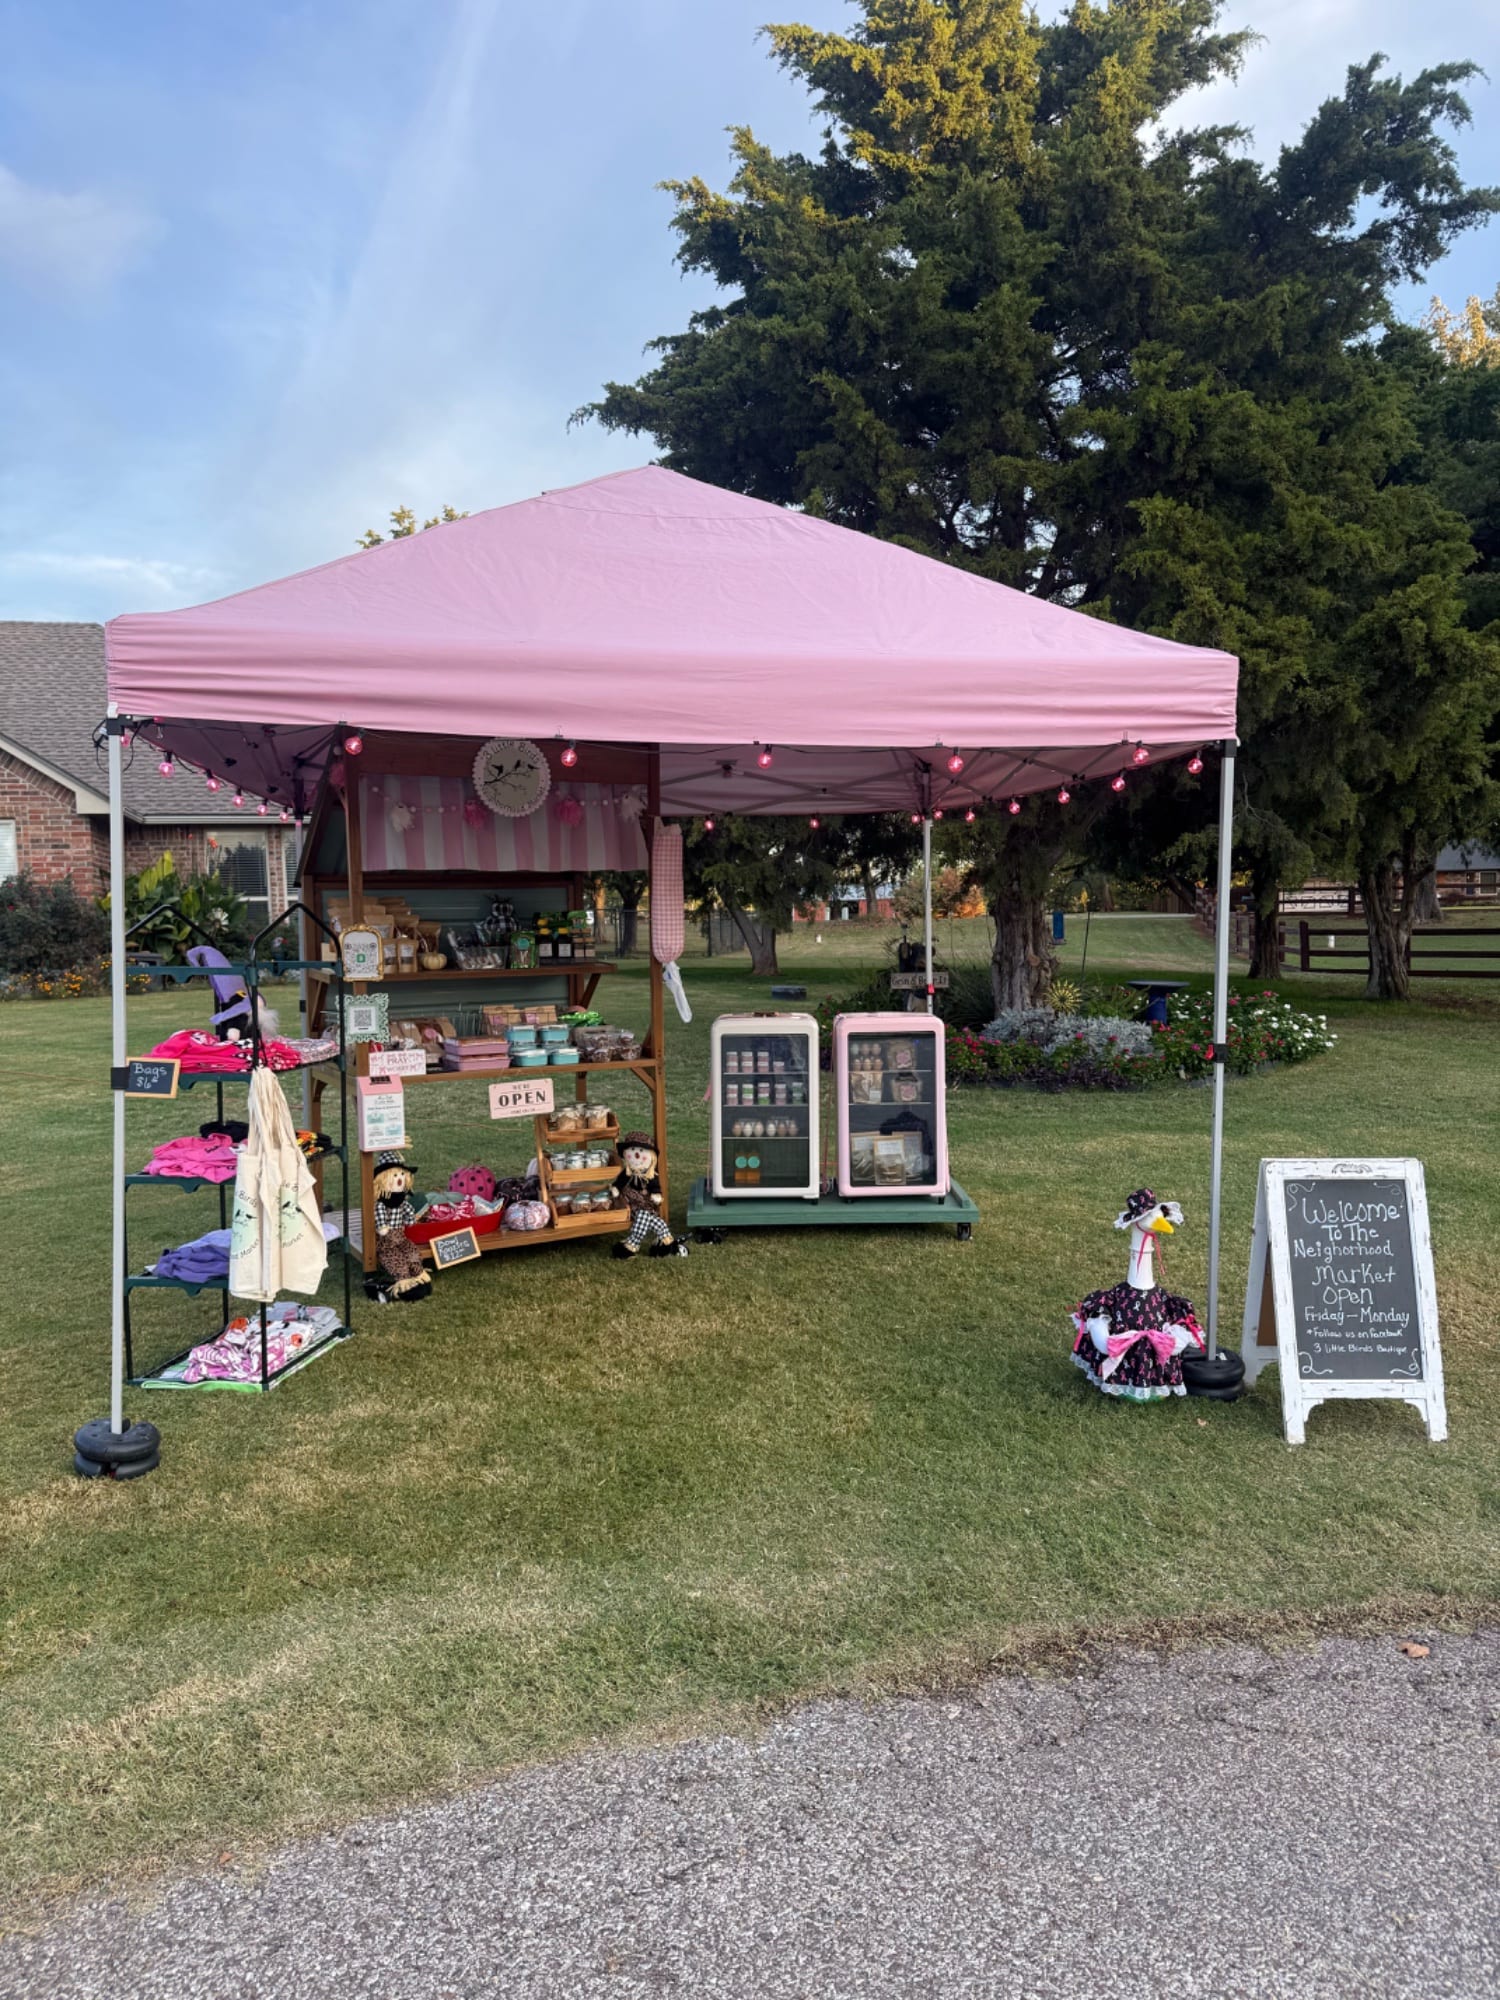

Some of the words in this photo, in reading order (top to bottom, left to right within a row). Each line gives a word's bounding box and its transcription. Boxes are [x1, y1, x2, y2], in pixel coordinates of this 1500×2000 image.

[518, 741, 540, 765] Birds
[132, 1062, 168, 1080] Bags
[498, 1090, 546, 1107] OPEN
[1302, 1198, 1400, 1224] Welcome
[1321, 1224, 1342, 1241] To
[1343, 1222, 1379, 1242] The
[1345, 1331, 1356, 1339] us
[1313, 1342, 1322, 1353] 3
